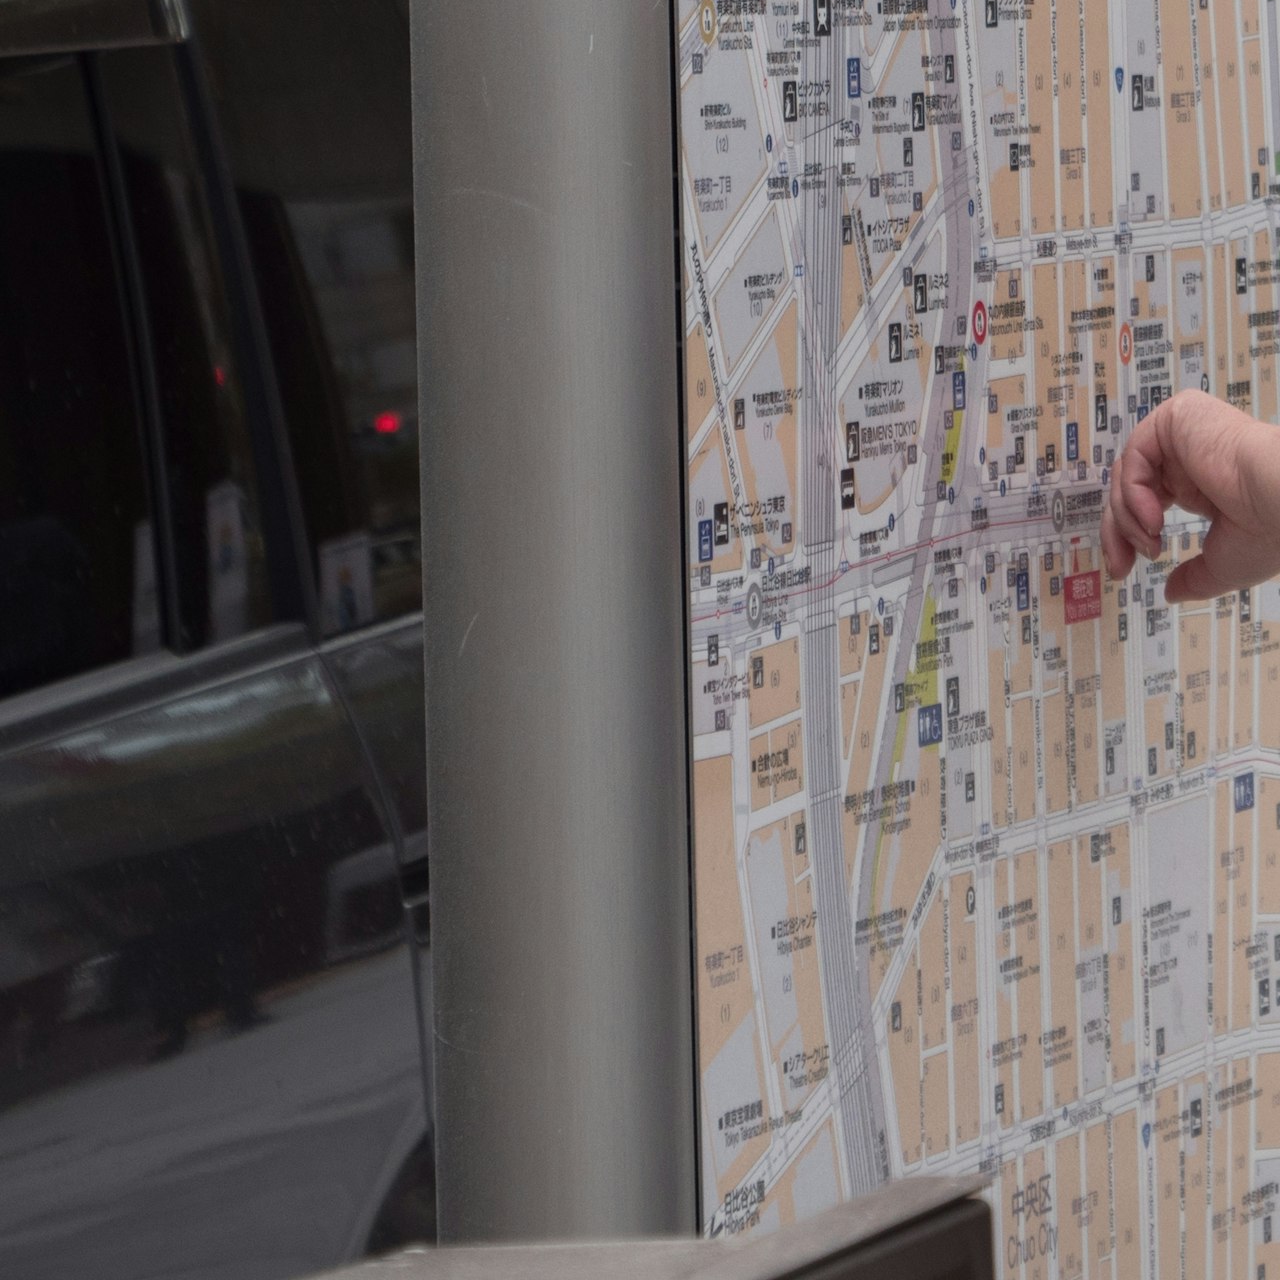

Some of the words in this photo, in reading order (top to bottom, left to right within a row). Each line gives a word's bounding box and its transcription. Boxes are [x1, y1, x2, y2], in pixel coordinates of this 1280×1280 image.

[1012, 1174, 1051, 1226] 中央区
[1008, 1225, 1036, 1270] Chuo
[1038, 1220, 1058, 1262] City
